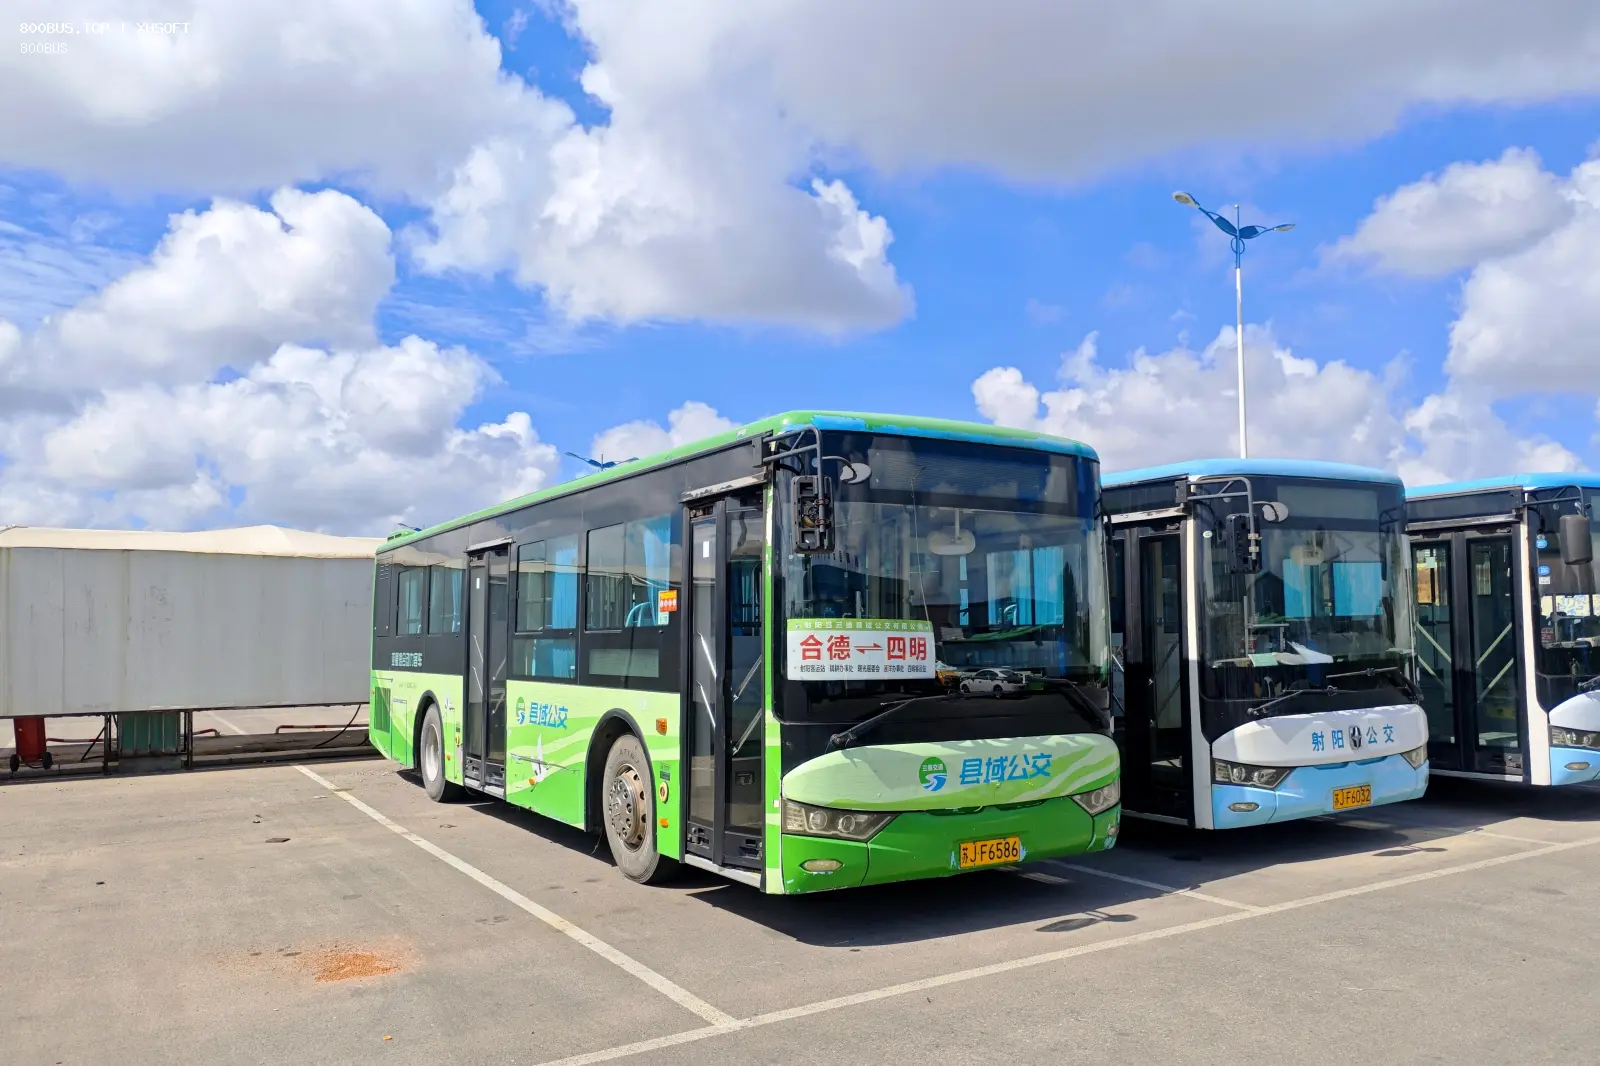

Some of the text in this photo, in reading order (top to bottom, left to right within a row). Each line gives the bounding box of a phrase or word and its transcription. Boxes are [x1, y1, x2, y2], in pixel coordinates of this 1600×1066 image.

[800, 634, 927, 661] 合德 四明
[529, 702, 569, 730] 县域公交
[1311, 724, 1395, 751] 射阳 公交
[959, 752, 1052, 785] 县域公交
